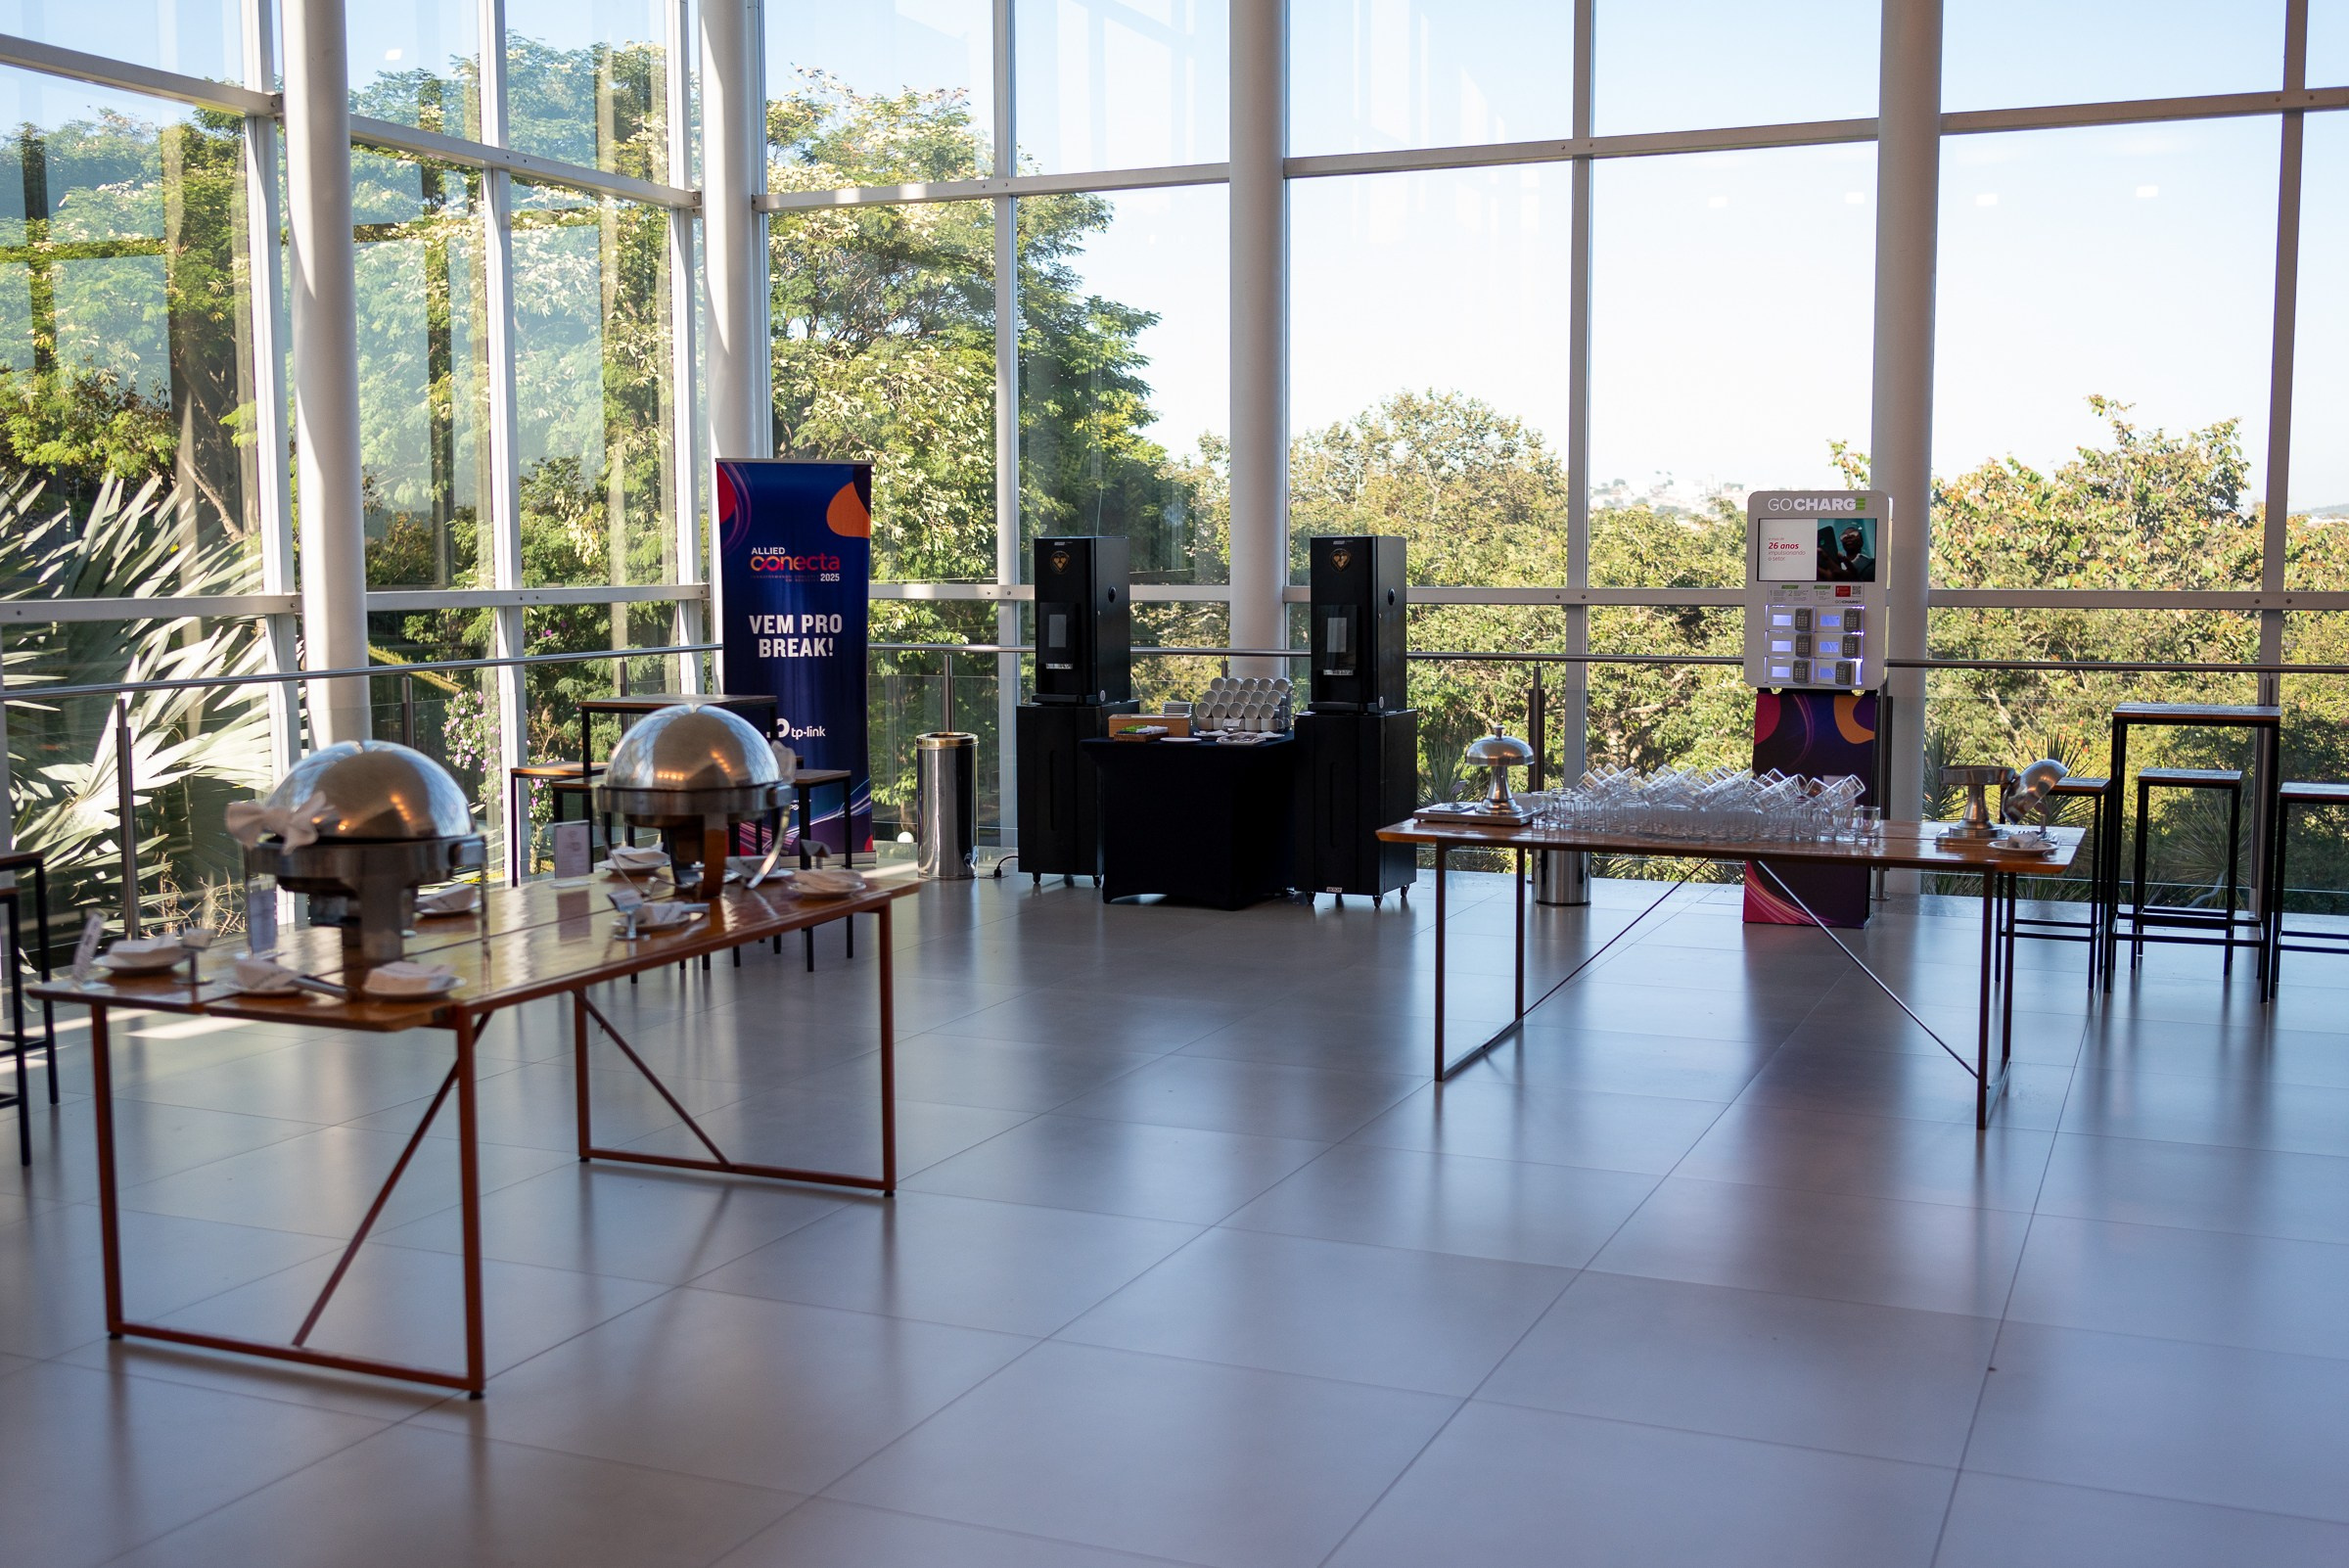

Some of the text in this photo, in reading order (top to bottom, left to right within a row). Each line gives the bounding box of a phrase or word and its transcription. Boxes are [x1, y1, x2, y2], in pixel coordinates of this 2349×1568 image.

[751, 546, 786, 555] ALLIED
[750, 553, 841, 571] conecta
[820, 573, 841, 582] 2025
[749, 614, 843, 634] VEM PRO
[759, 638, 834, 658] BREAK!
[791, 725, 826, 740] tp-link
